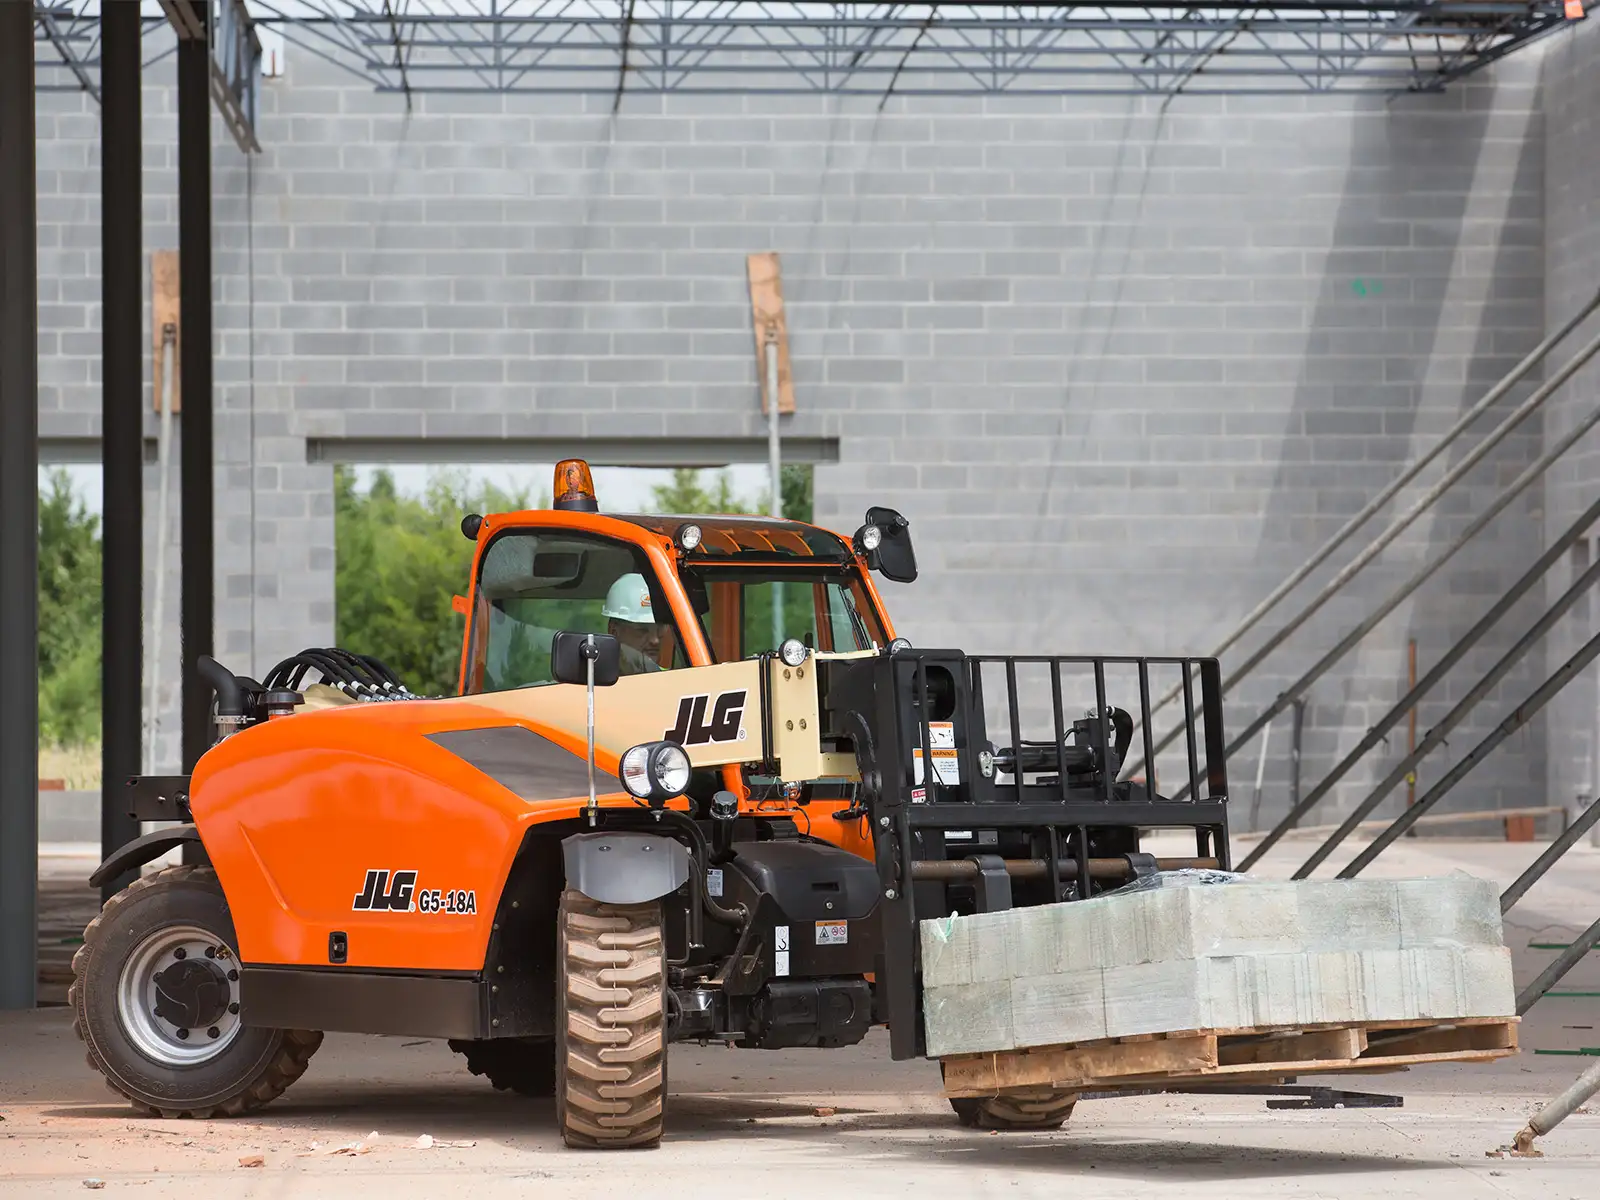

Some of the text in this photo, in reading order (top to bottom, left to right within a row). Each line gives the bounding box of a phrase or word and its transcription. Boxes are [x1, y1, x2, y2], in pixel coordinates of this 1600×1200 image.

[664, 690, 747, 745] JLG
[353, 870, 476, 913] JLG G5-18A
